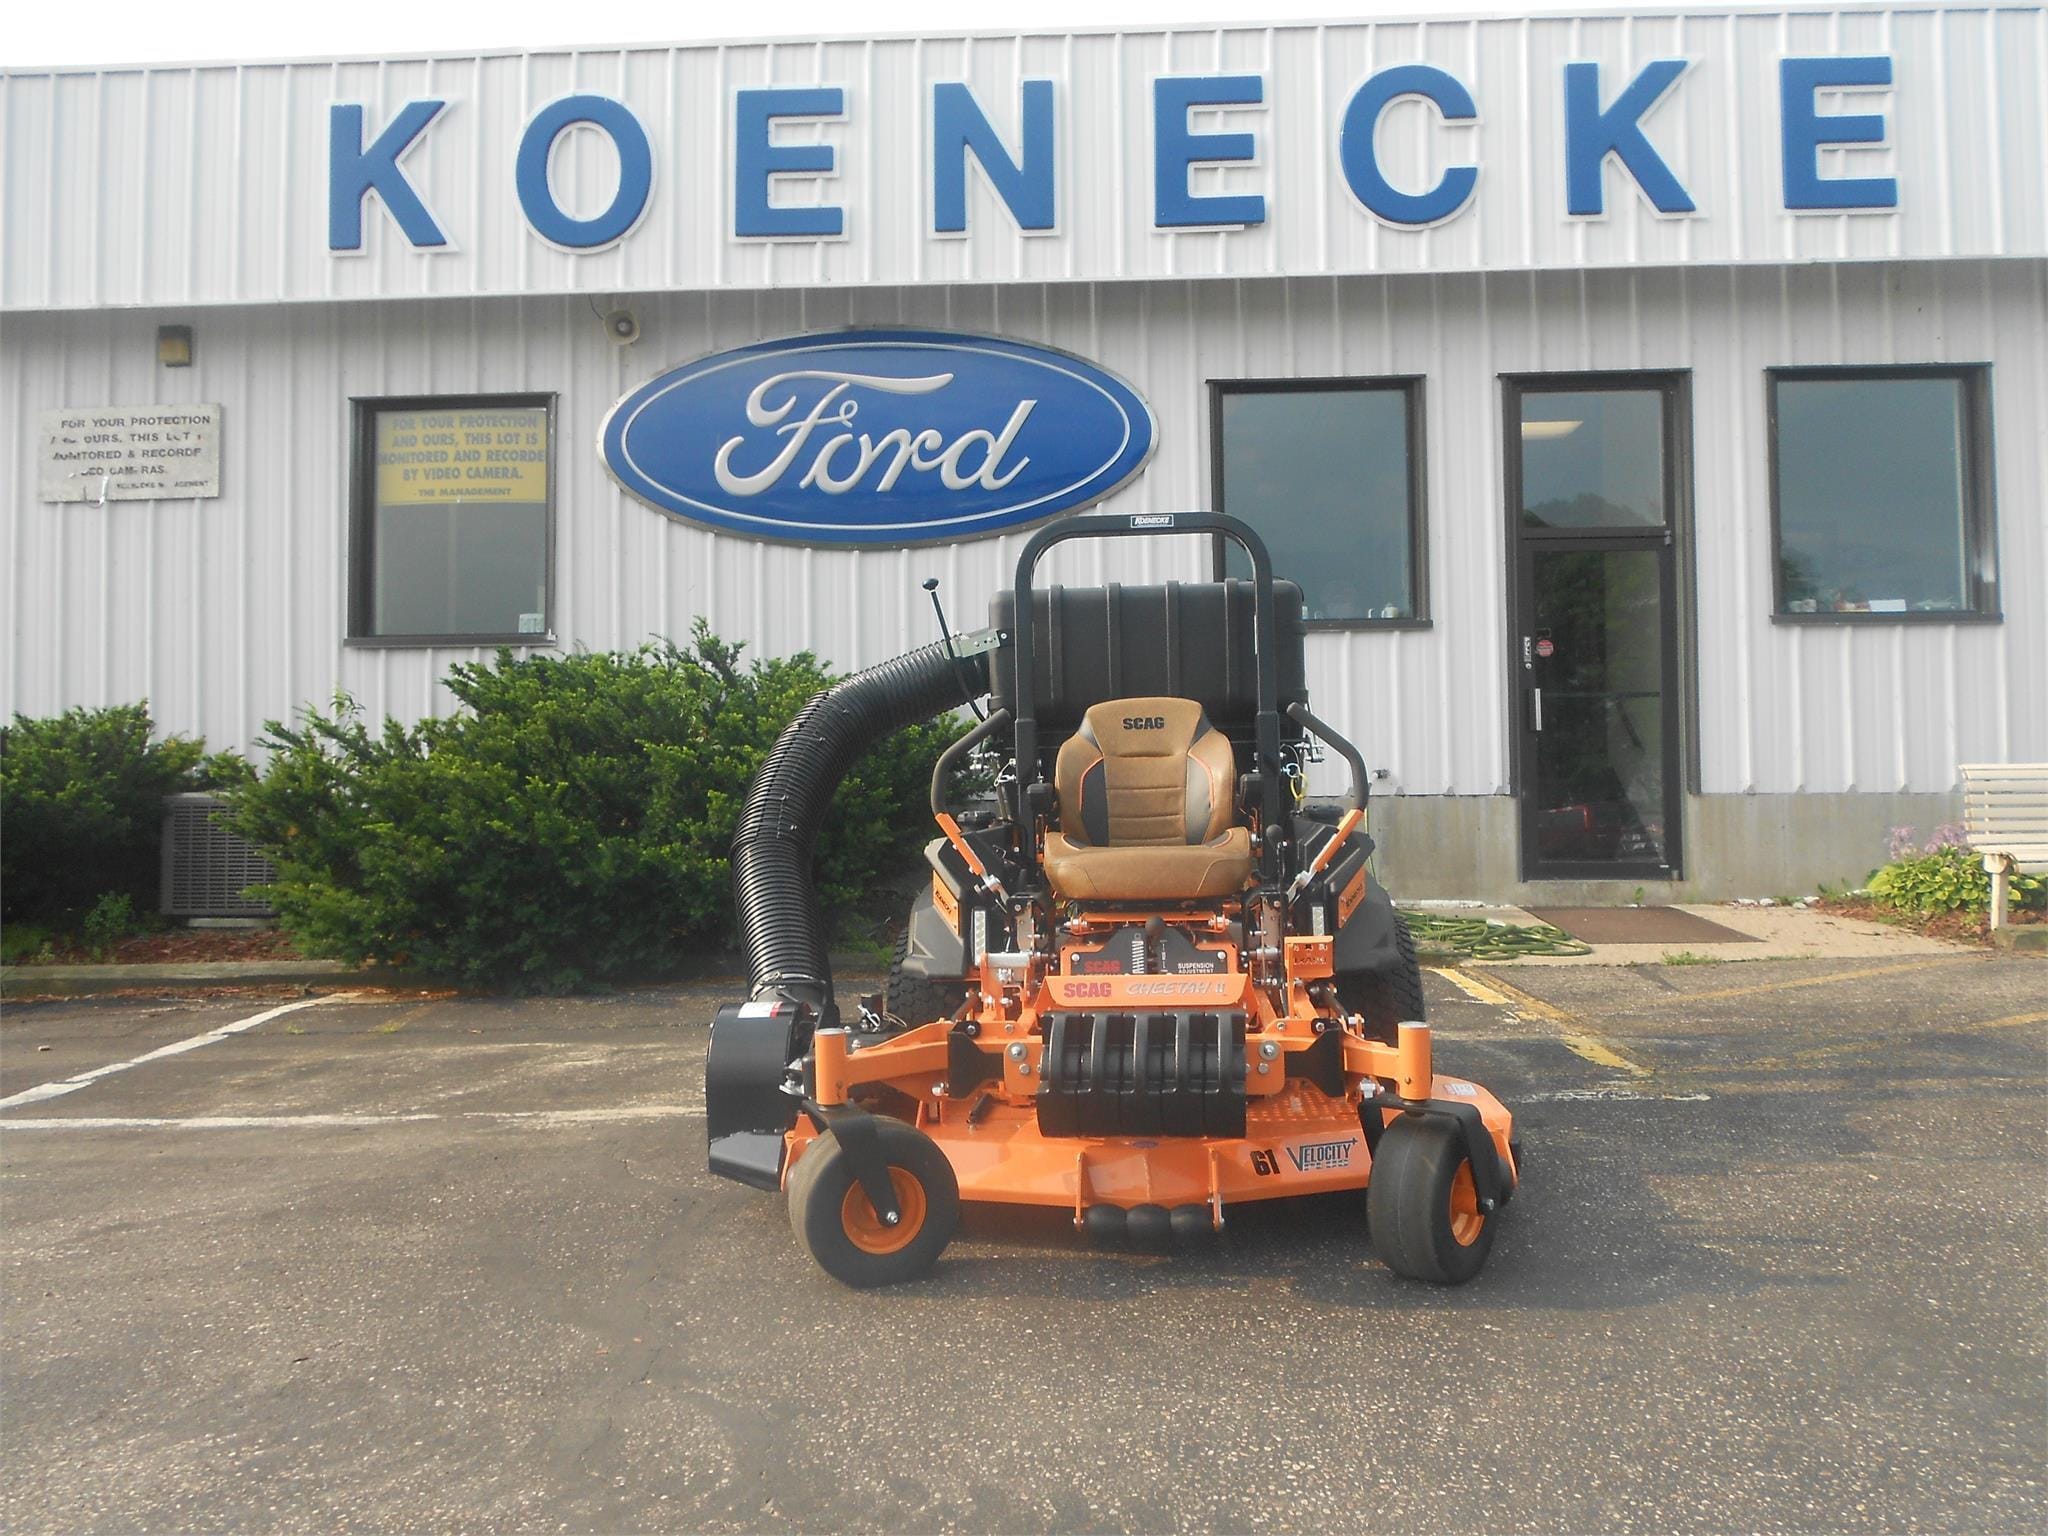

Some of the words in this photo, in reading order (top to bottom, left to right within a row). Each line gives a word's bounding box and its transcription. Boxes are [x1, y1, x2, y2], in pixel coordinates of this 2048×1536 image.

[328, 57, 1898, 250] KOENECKE
[61, 420, 86, 428] FOR
[92, 418, 125, 427] YOUR
[130, 415, 211, 426] PROTECTION
[392, 417, 416, 430] FOR
[421, 416, 454, 429] YOUR
[459, 415, 537, 428] PROTECTION
[129, 432, 159, 442] THIS
[392, 434, 417, 448] AND
[422, 433, 459, 447] OURS,
[464, 432, 492, 445] THIS
[497, 432, 521, 445] LOT
[525, 432, 538, 445] IS
[714, 371, 1038, 496] Ford
[454, 449, 481, 462] AND
[403, 467, 418, 481] BY
[423, 467, 461, 480] VIDEO
[466, 466, 523, 479] CAMERA.
[418, 488, 435, 497] THE
[439, 487, 512, 497] MANAGEMENT
[1123, 717, 1164, 729] SCAG
[1064, 982, 1112, 998] SCAG
[1126, 980, 1212, 996] CHEETAH
[1250, 1149, 1280, 1176] 61
